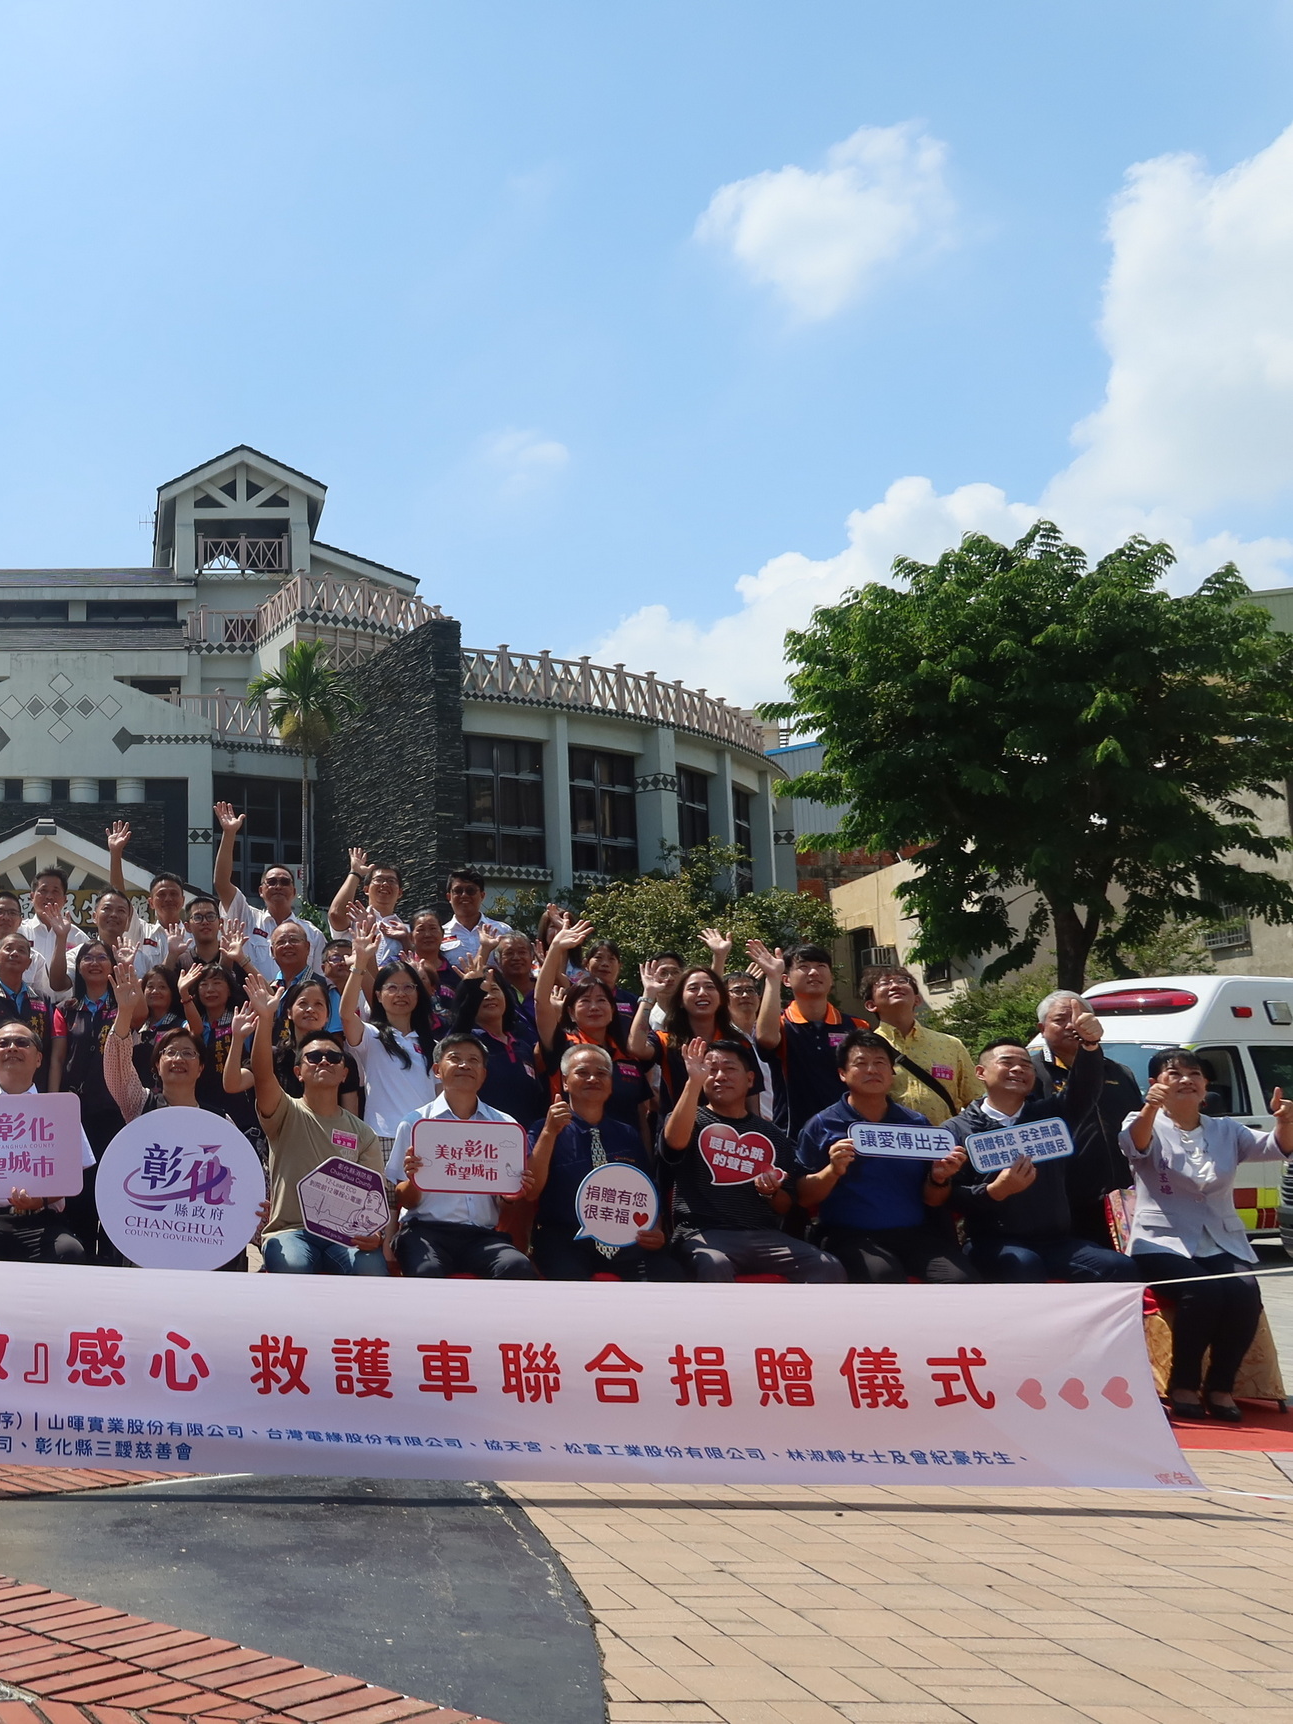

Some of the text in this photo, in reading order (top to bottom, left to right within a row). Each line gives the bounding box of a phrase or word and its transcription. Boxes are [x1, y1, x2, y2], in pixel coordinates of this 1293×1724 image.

[435, 1139, 498, 1160] 美好彰化
[858, 1129, 950, 1151] 讓愛傳出去
[141, 1143, 224, 1205] 彰化
[444, 1162, 498, 1181] 希望城市
[585, 1185, 647, 1207] 捐贈有您
[174, 1203, 224, 1221] 縣政府
[584, 1204, 630, 1225] 很幸福
[125, 1216, 224, 1237] CHANGHUA
[125, 1229, 224, 1246] COUNTY GOVERNMENT
[249, 1333, 996, 1410] 救護車聯合捐贈儀式
